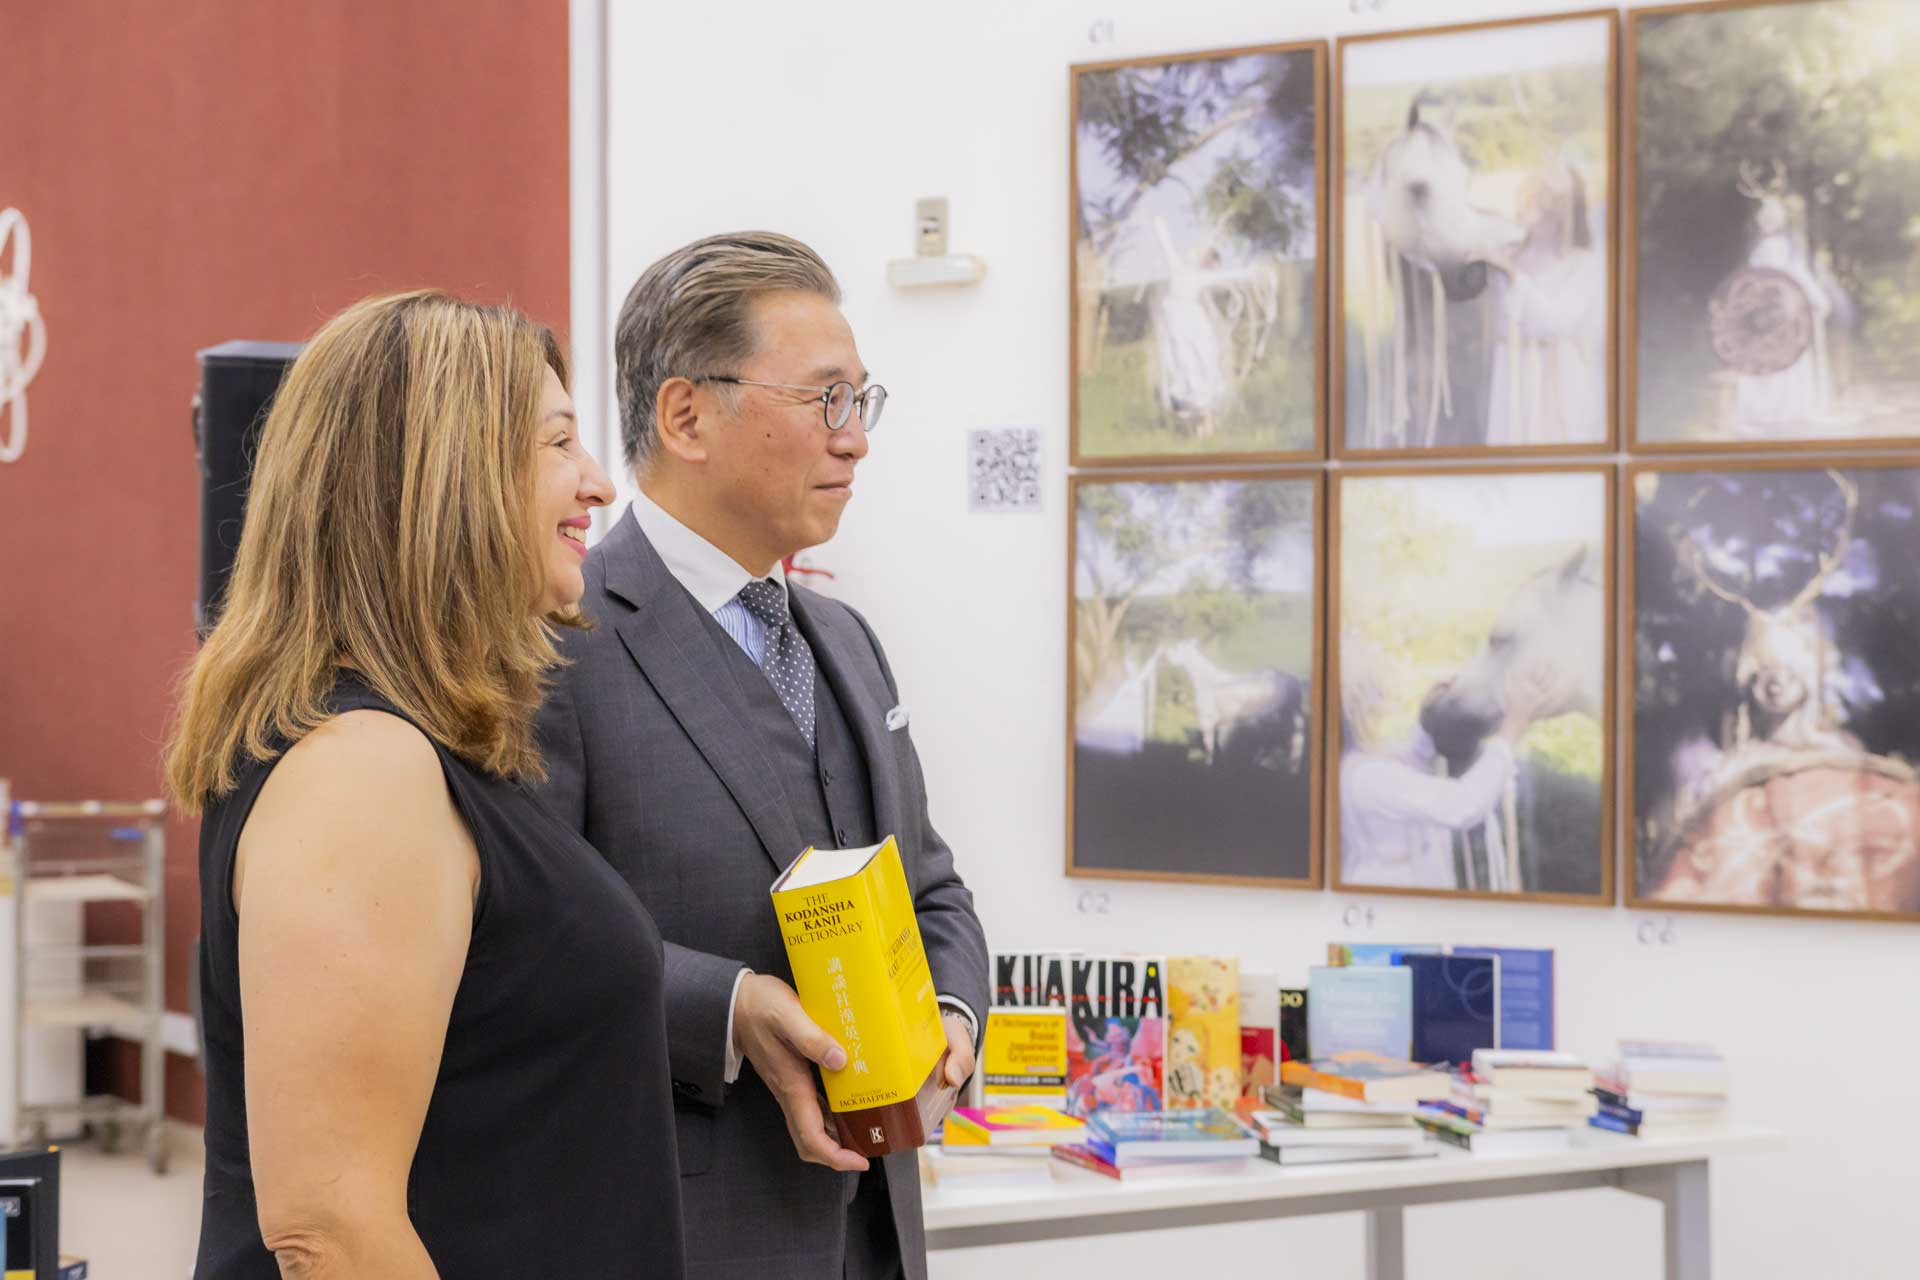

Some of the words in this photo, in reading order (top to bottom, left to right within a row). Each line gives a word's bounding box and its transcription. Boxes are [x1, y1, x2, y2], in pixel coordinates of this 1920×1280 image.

[803, 893, 829, 907] THE
[784, 899, 856, 923] KODANSHA
[787, 920, 865, 946] DICTIONARY
[803, 914, 842, 931] KANJI
[1046, 959, 1164, 1018] AKIRA
[839, 1098, 859, 1108] JACK
[859, 1089, 898, 1105] HALPERN
